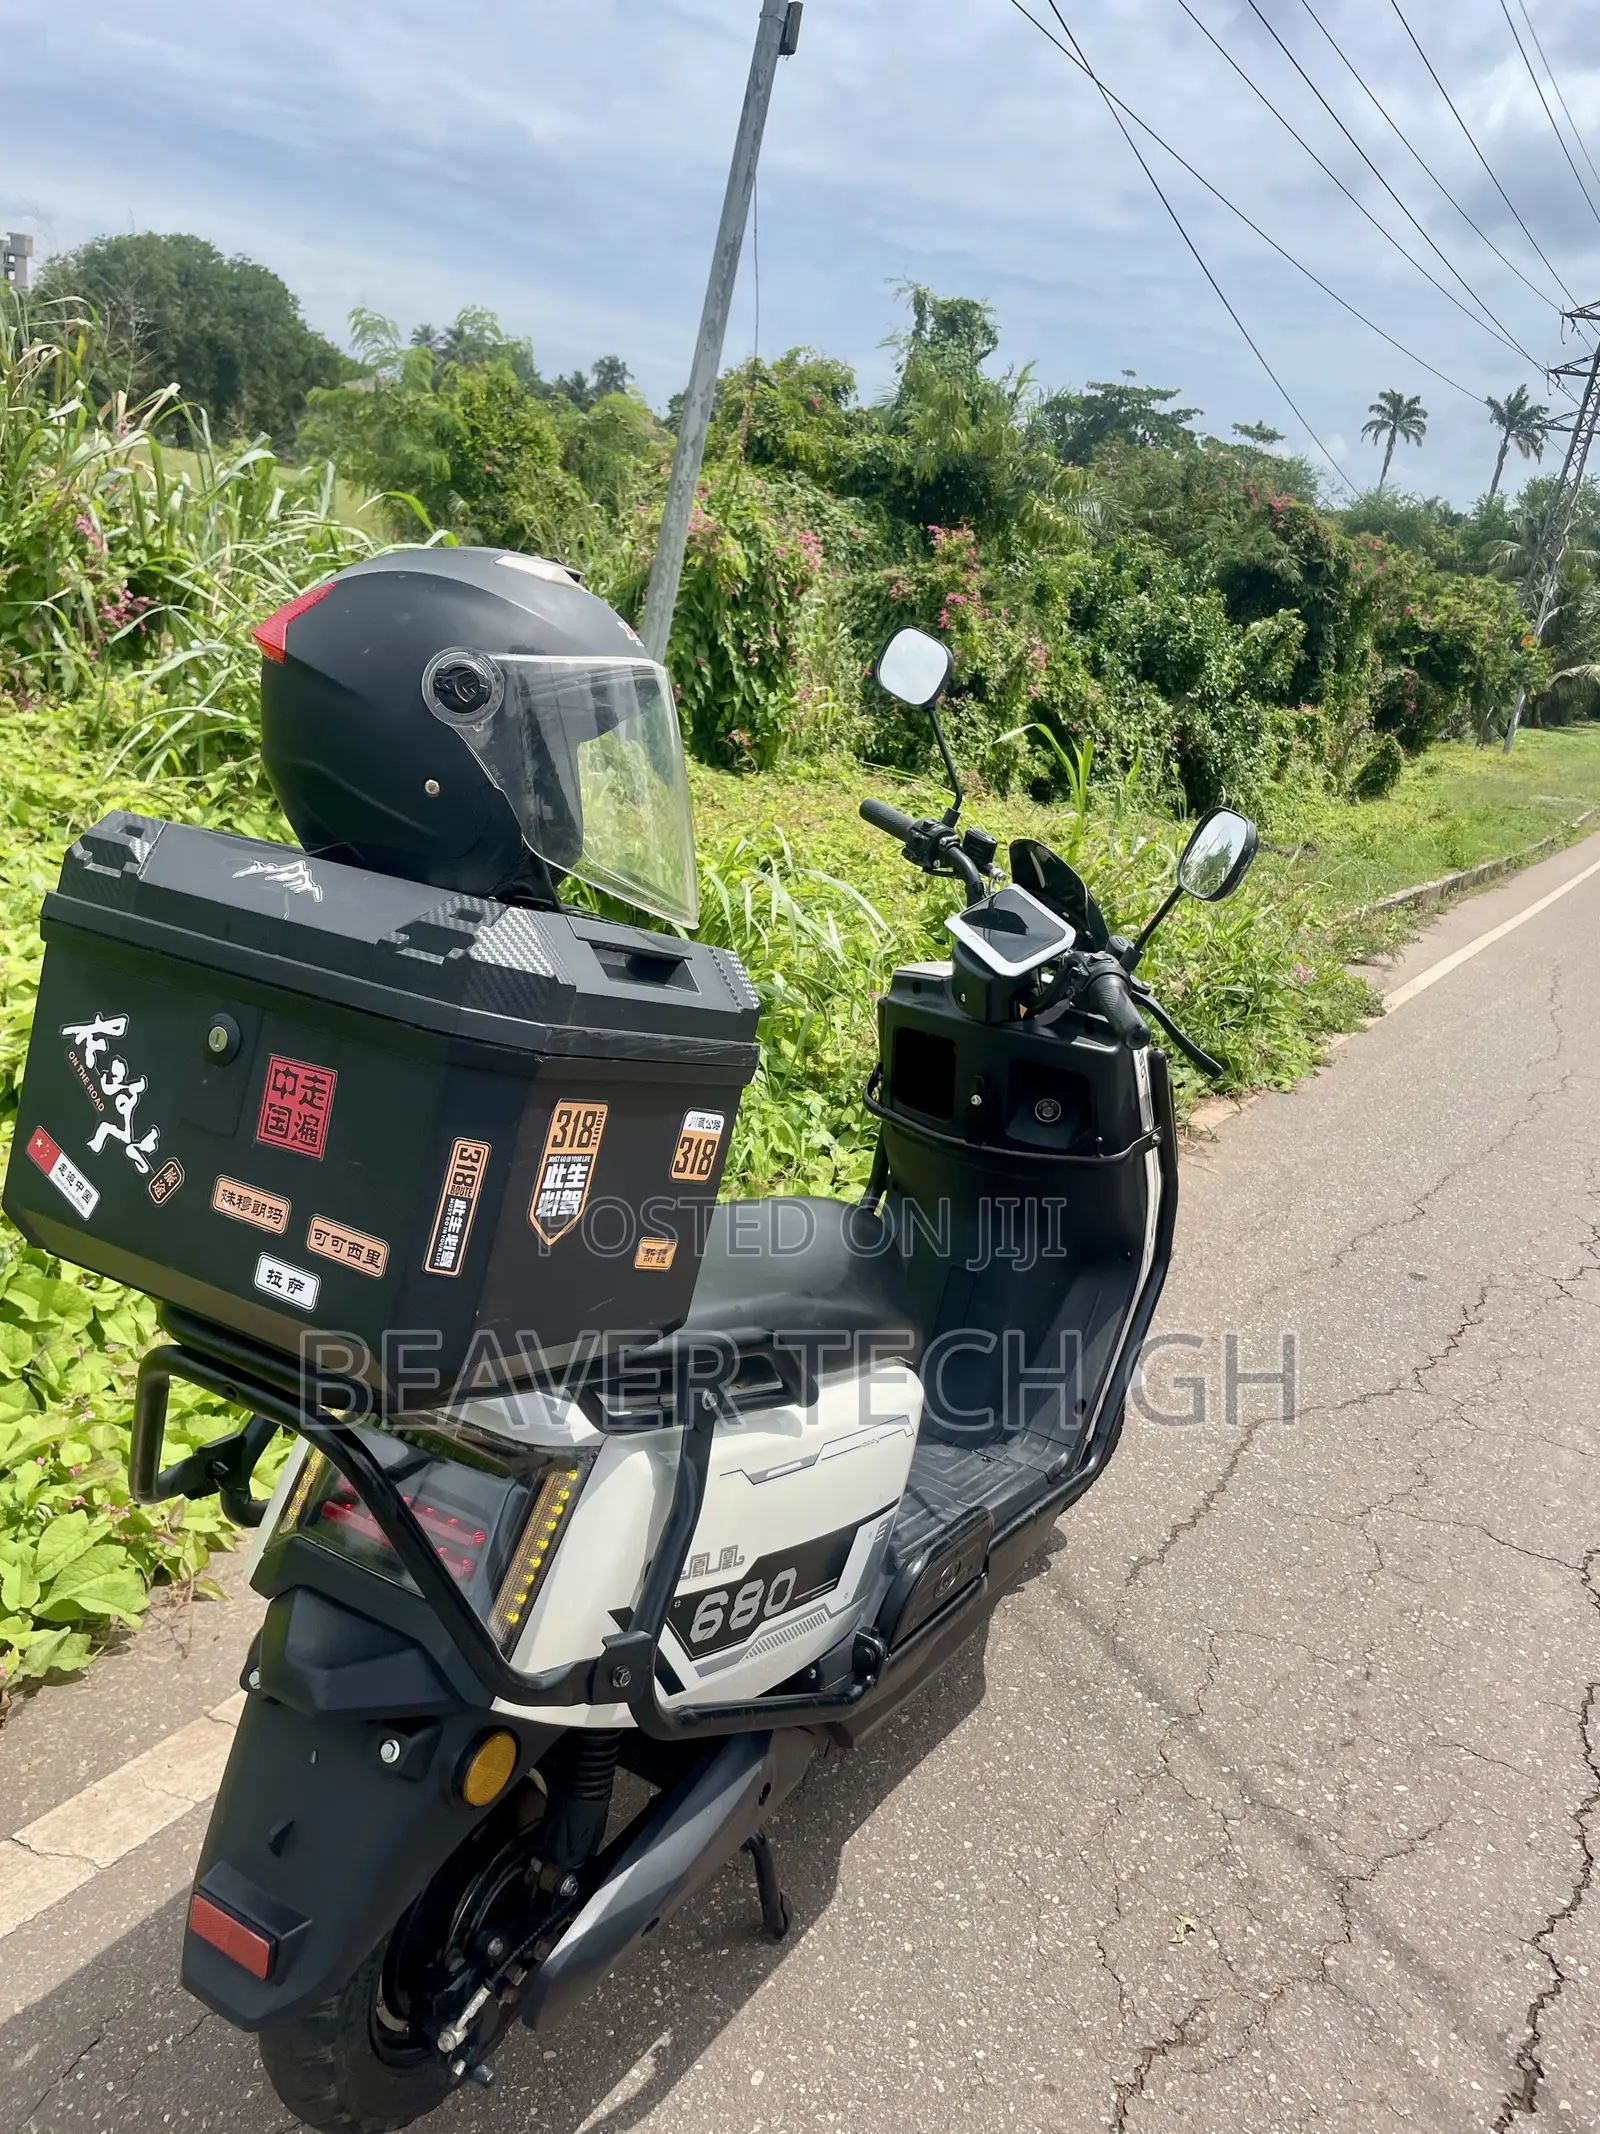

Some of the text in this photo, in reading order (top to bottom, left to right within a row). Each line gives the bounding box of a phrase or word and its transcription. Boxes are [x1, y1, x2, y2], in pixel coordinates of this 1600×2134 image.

[68, 1050, 105, 1112] ON THE ROAD
[551, 1110, 598, 1148] 318
[591, 1111, 604, 1147] ROUTE
[452, 1147, 481, 1187] 318
[673, 1137, 717, 1175] 318
[450, 1184, 473, 1198] ROUTE
[542, 1163, 588, 1189] 此生
[221, 1188, 283, 1225] 珠穆朗玛
[444, 1217, 450, 1227] GO
[446, 1198, 455, 1217] MUST
[314, 1228, 382, 1269] 可可西里
[434, 1252, 442, 1267] LIFE
[438, 1233, 446, 1252] YOUR
[266, 1268, 305, 1295] 拉萨
[689, 1567, 798, 1644] 680
